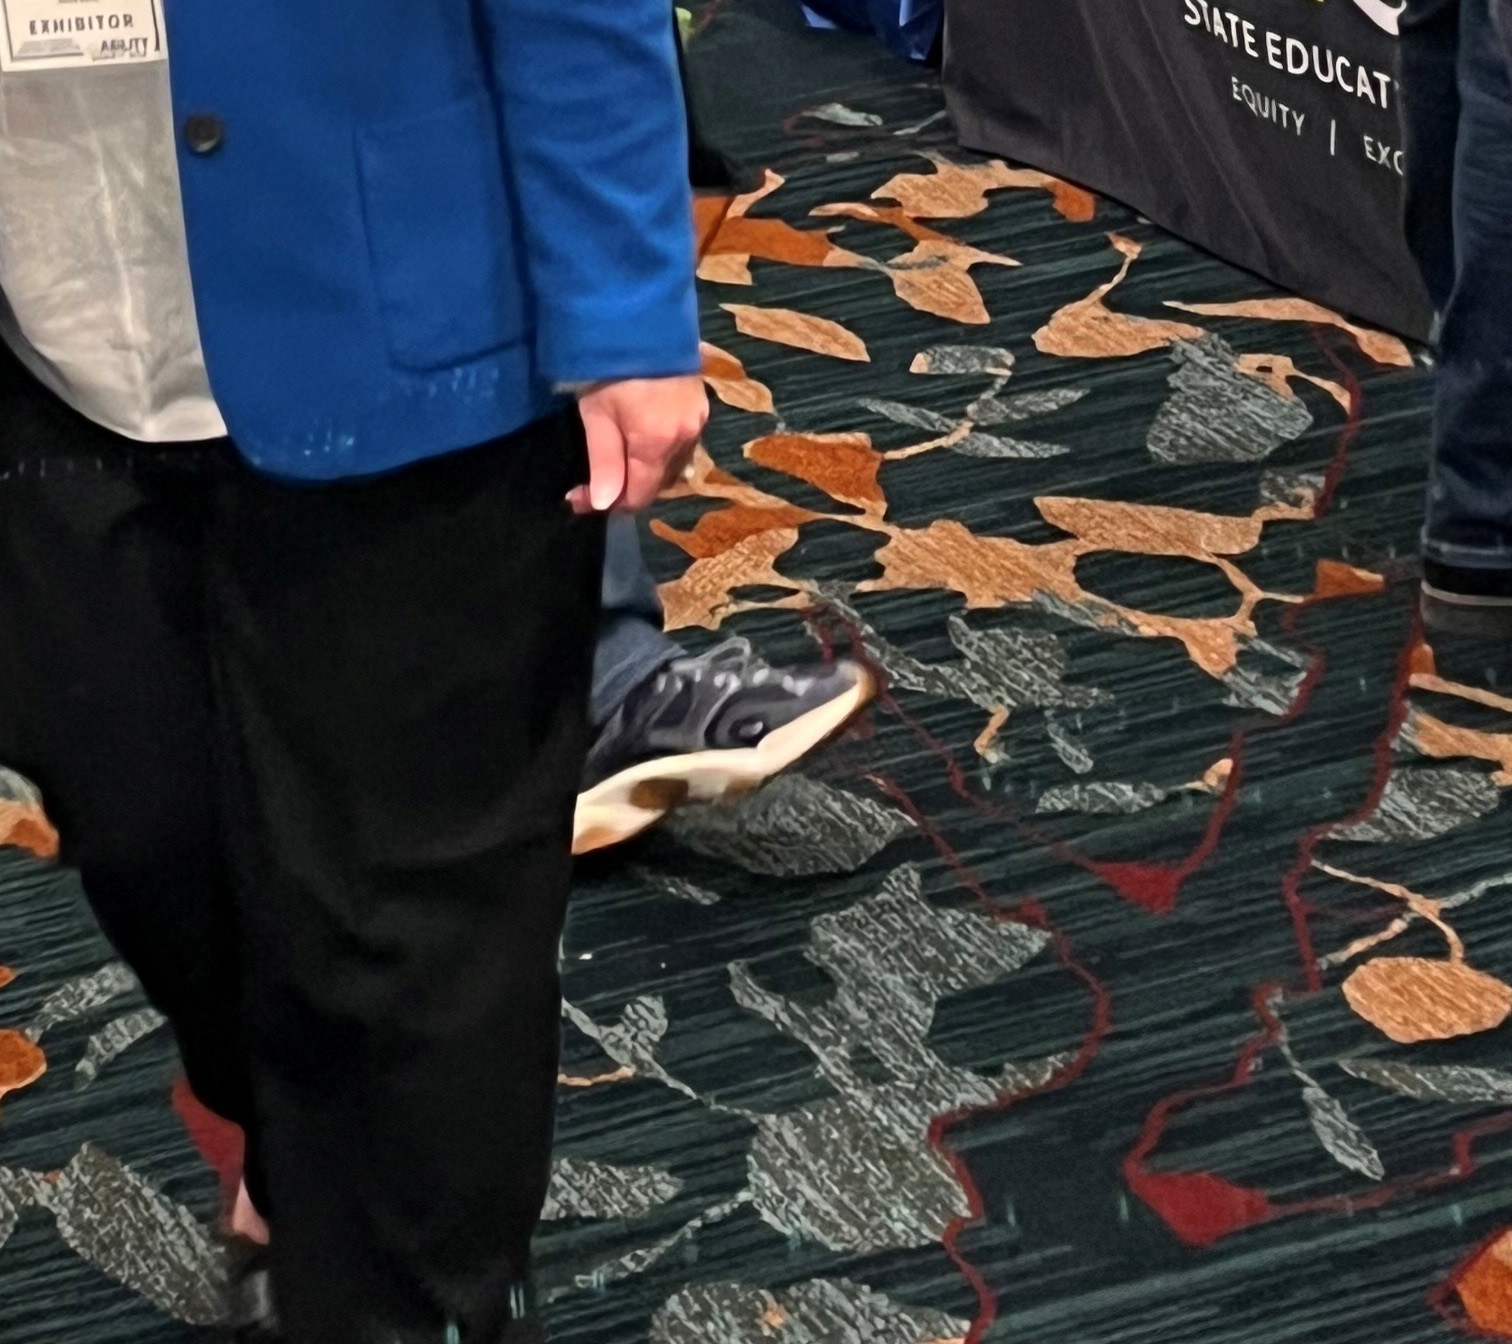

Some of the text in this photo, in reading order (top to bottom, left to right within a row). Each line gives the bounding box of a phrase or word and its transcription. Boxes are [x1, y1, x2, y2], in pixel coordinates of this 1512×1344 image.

[29, 13, 134, 35] EXHIBITOR
[1265, 30, 1400, 109] EDUCAT
[1231, 75, 1305, 136] EQUITY
